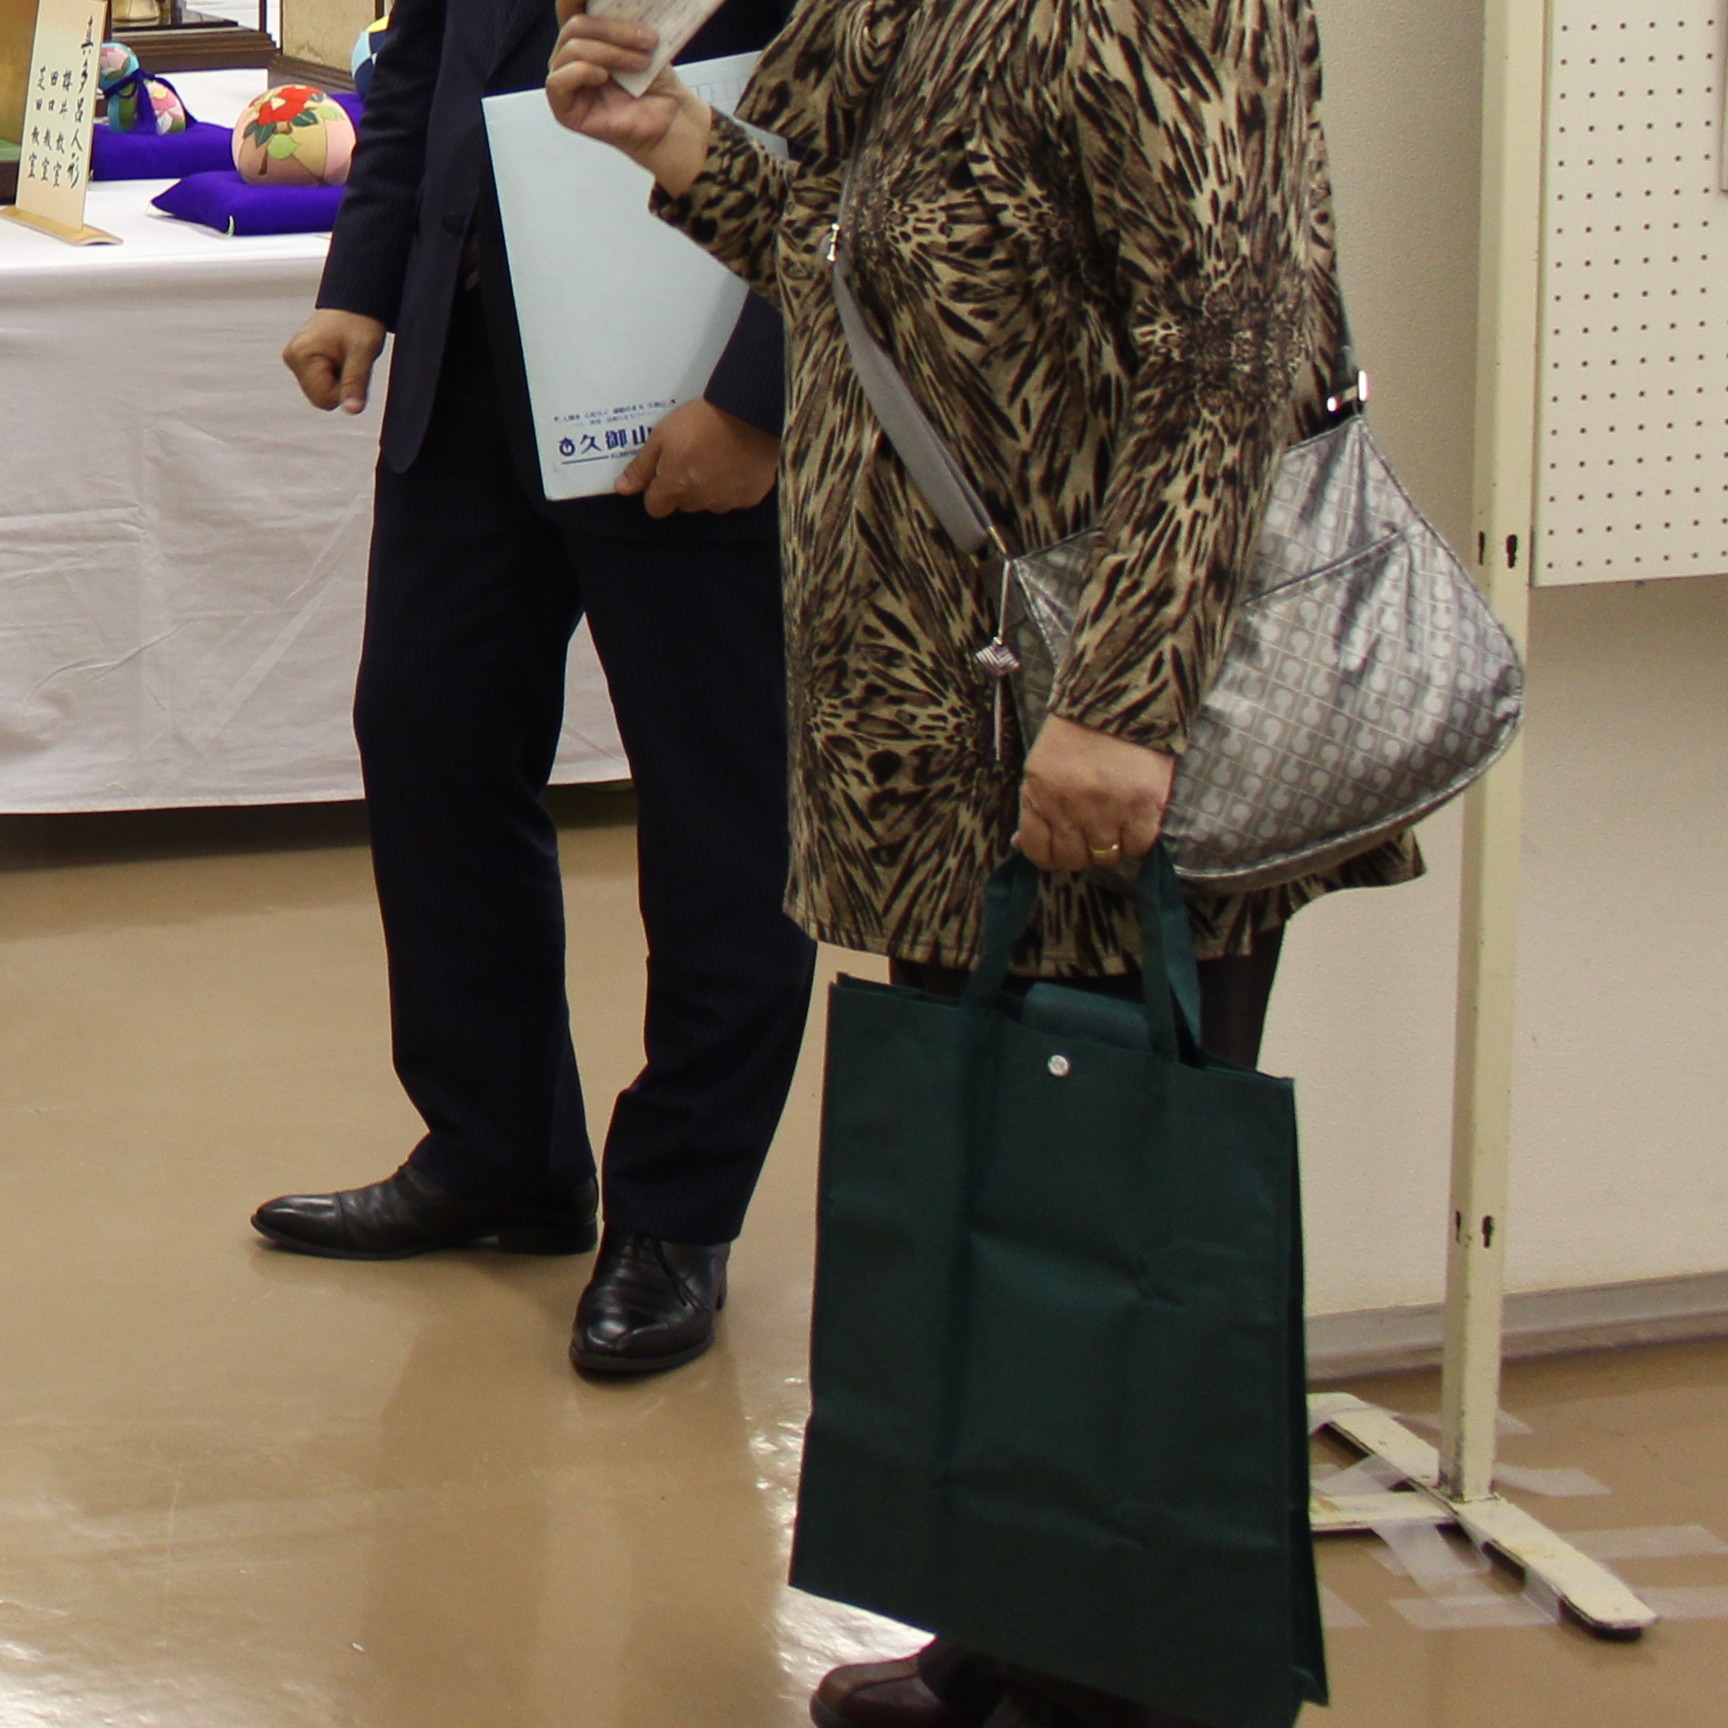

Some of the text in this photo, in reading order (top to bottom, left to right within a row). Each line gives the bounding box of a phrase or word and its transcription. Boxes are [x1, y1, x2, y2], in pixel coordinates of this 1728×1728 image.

[65, 15, 95, 191] 真多呂人形
